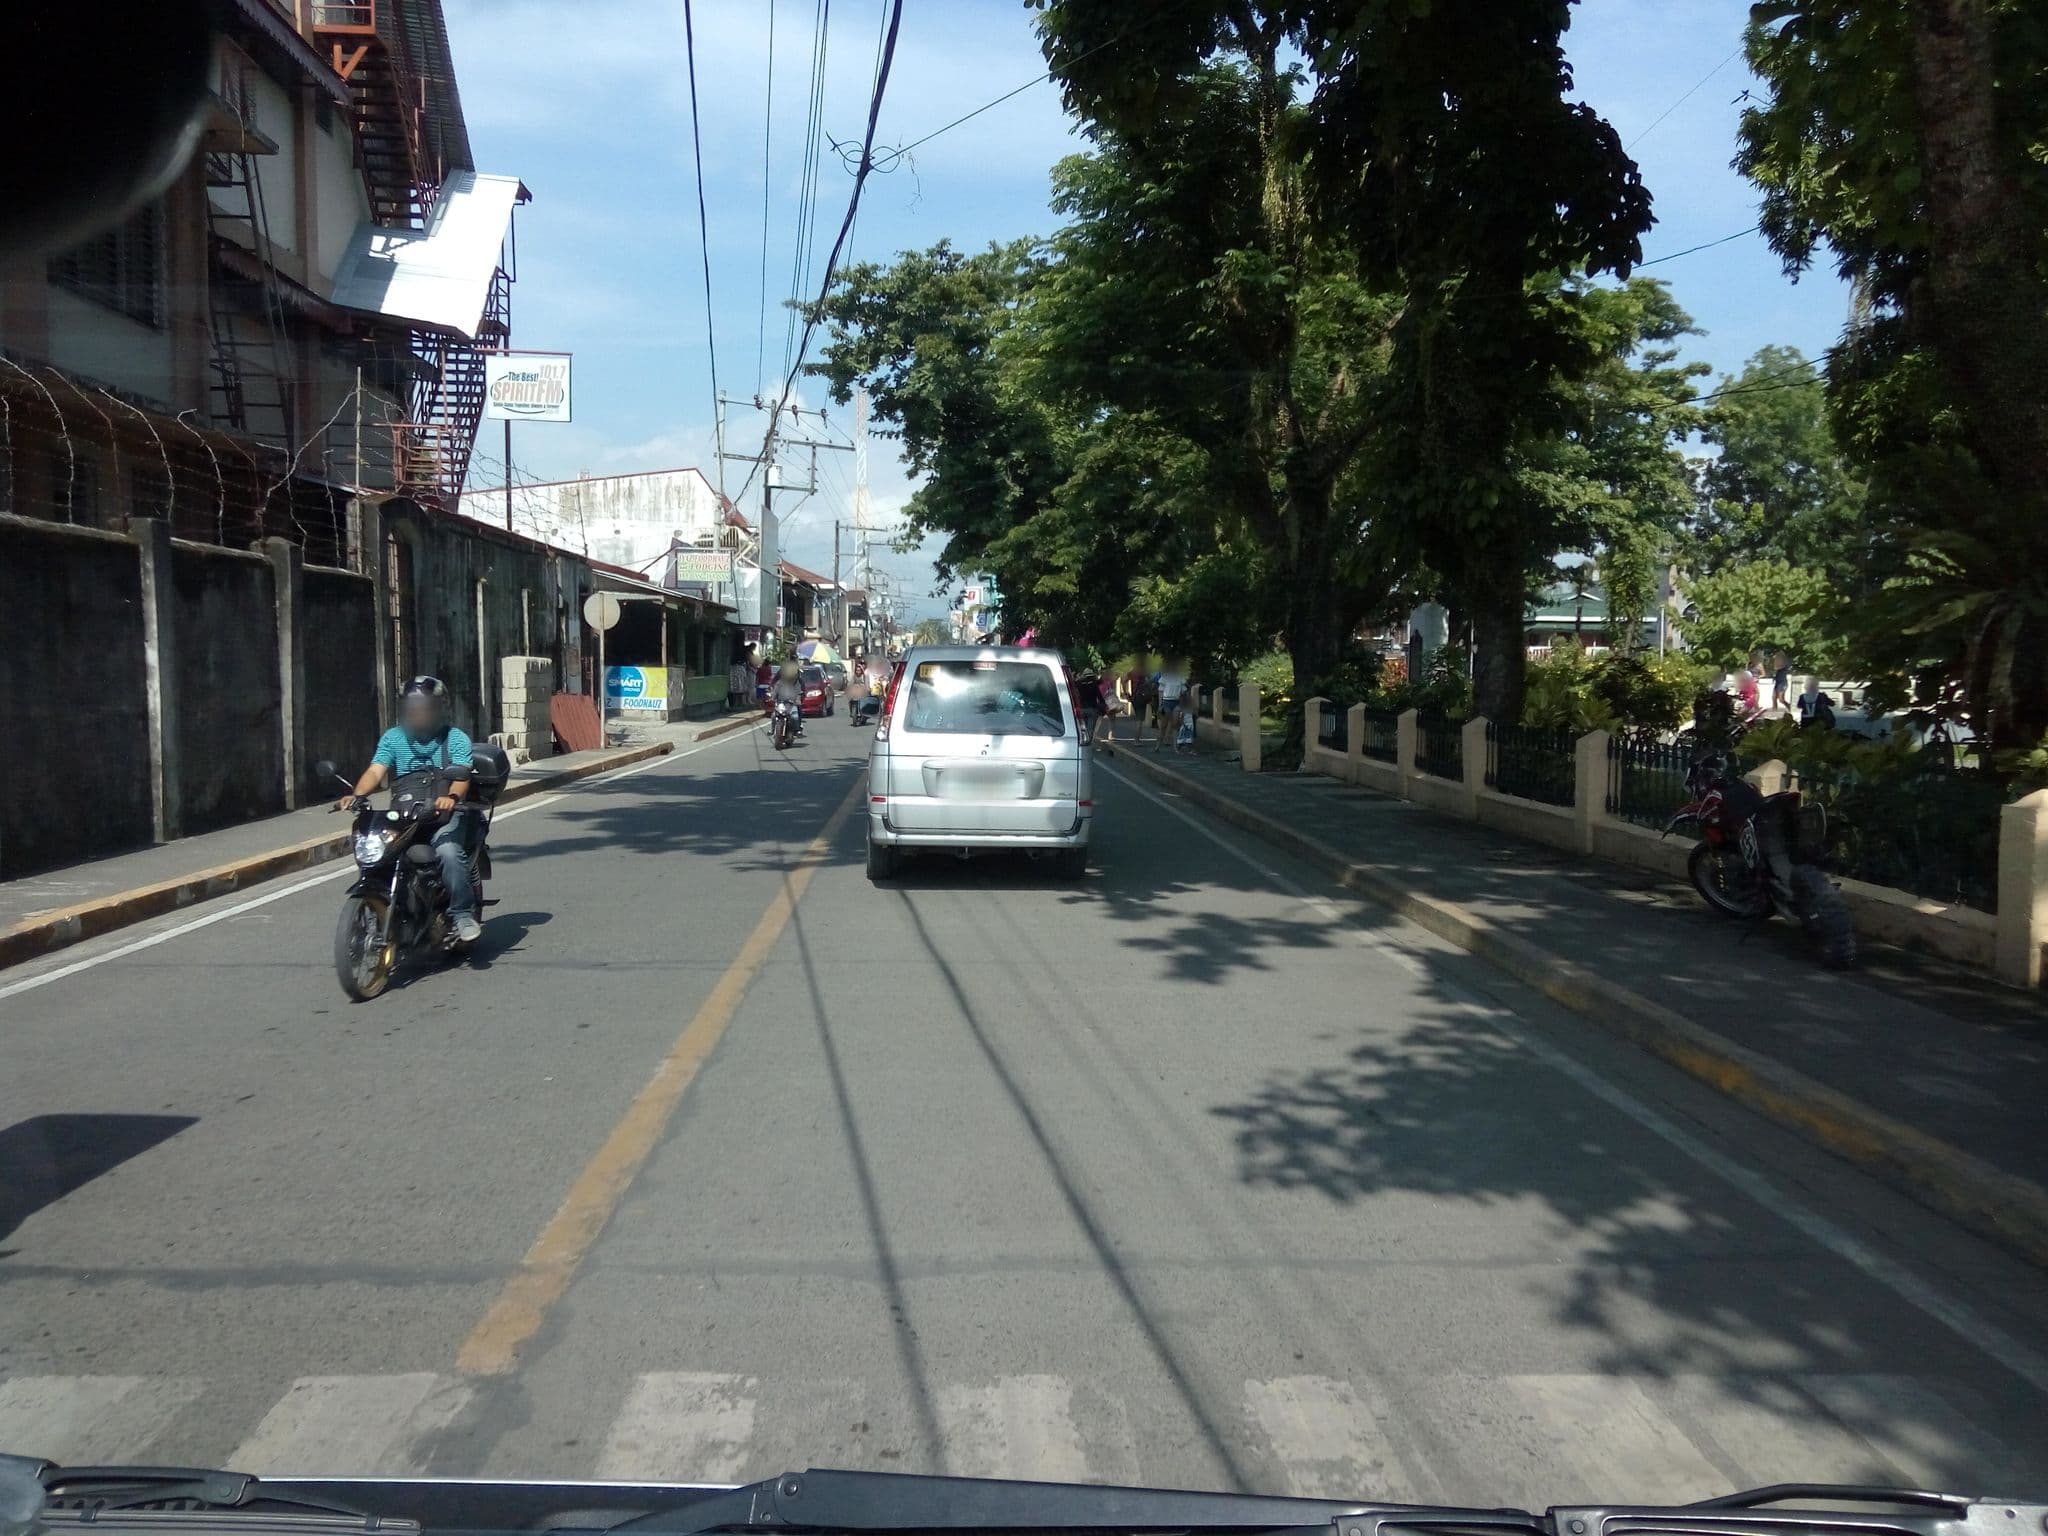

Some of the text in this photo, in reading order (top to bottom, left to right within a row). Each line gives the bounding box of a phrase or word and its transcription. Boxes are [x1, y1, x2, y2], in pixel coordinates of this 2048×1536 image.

[508, 371, 521, 381] The
[539, 365, 566, 380] 101.7
[608, 678, 643, 687] SMART
